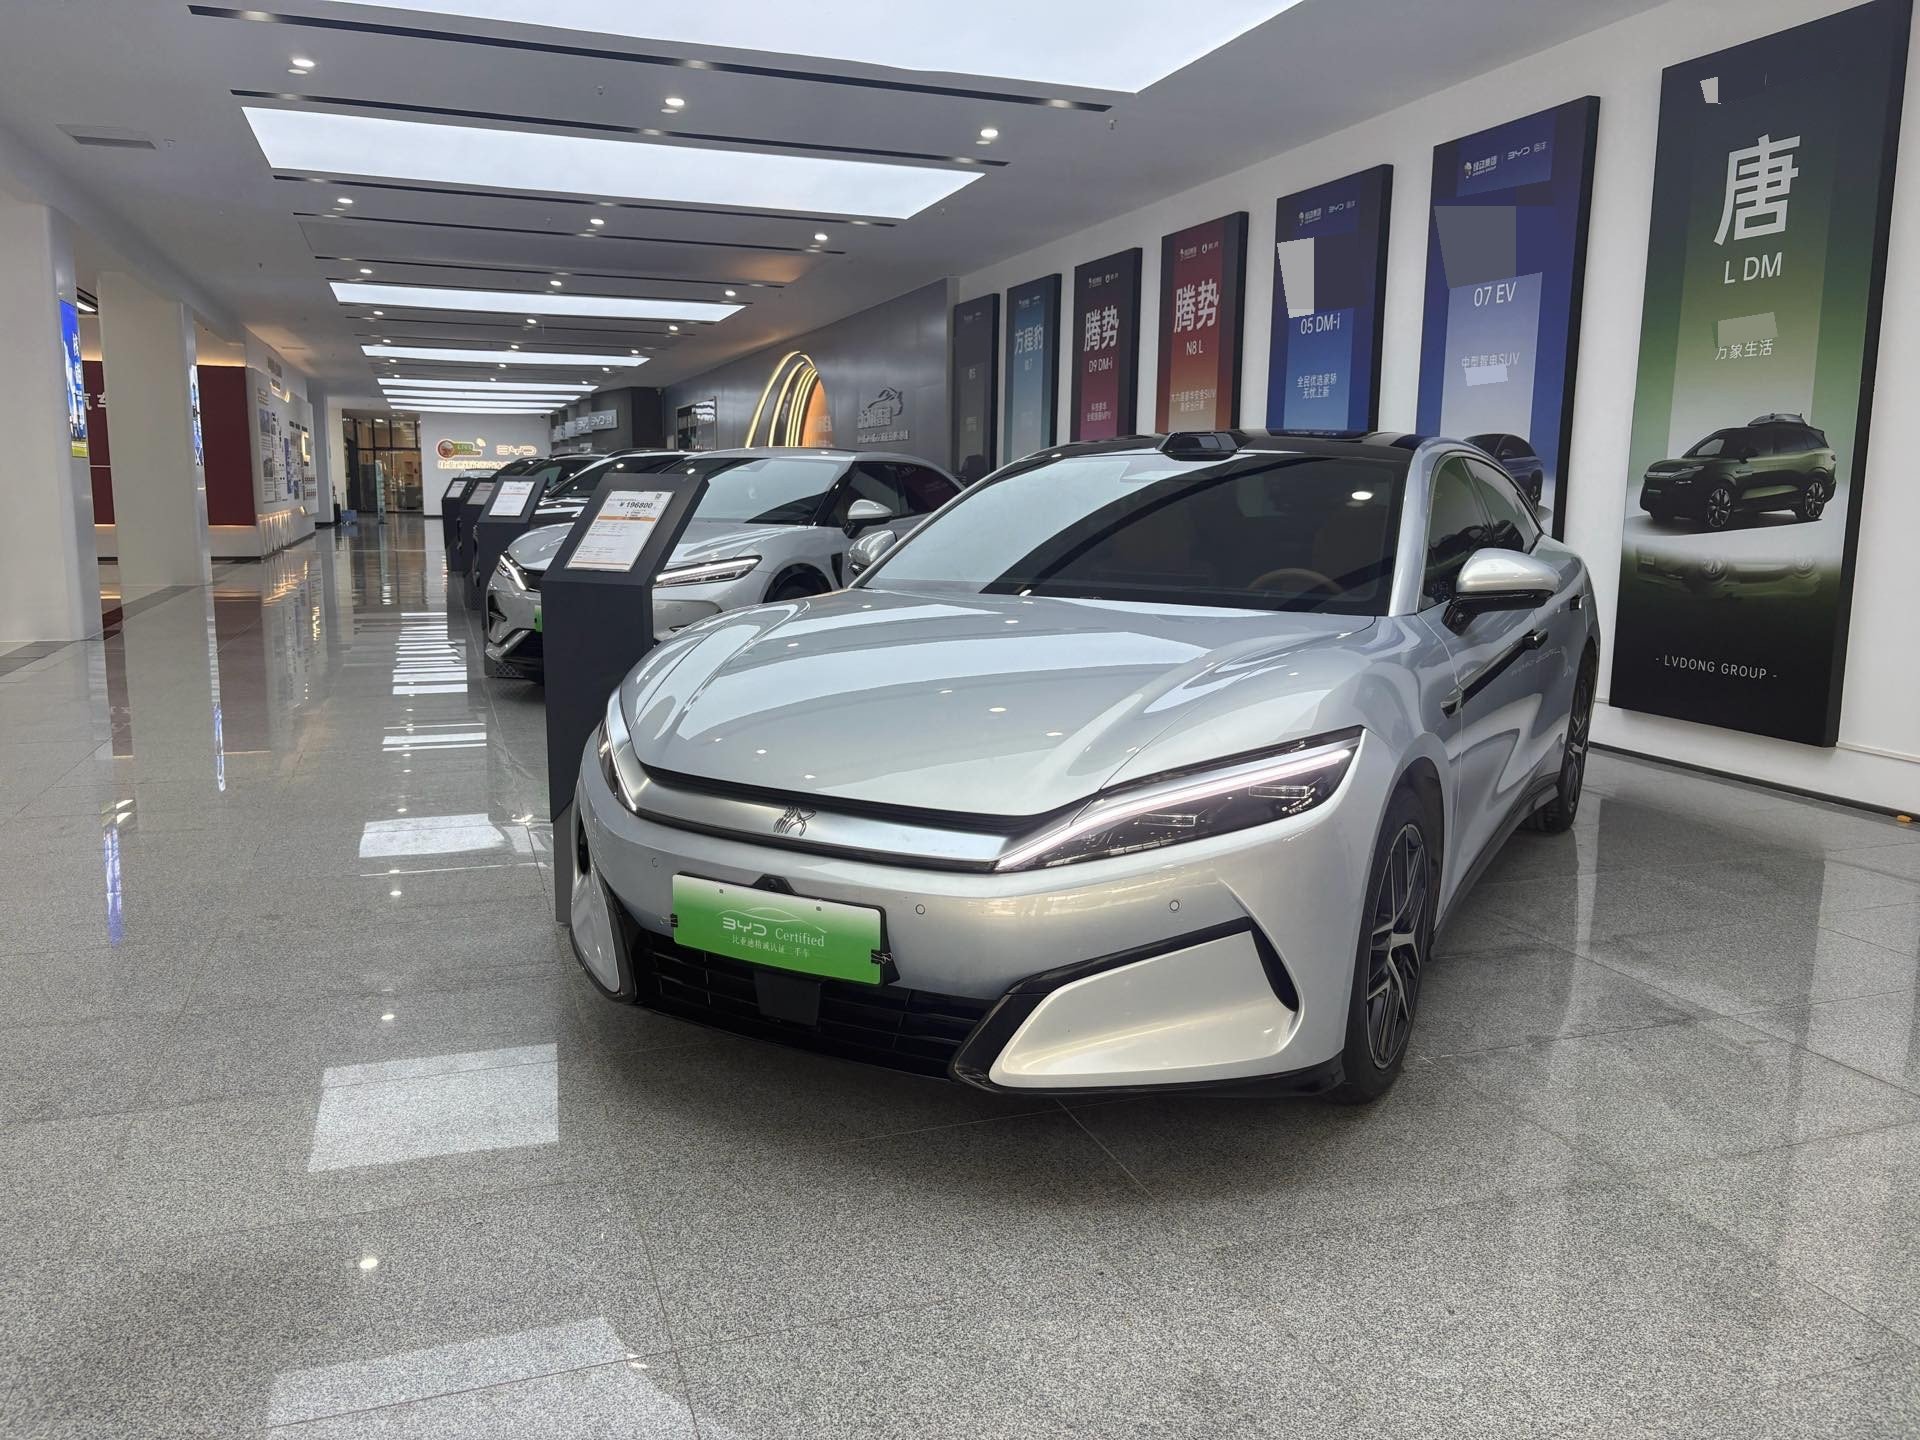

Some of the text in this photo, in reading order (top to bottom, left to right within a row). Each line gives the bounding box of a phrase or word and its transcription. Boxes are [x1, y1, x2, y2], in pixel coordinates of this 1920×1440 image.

[1507, 146, 1531, 160] BYD
[1713, 133, 1801, 246] 唐
[1724, 252, 1783, 284] L DM
[1173, 277, 1220, 334] 腾势
[1473, 281, 1517, 307] 07 EV
[1083, 304, 1120, 352] 腾势
[1300, 312, 1341, 335] 05 DM-i
[1014, 323, 1044, 355] 方程豹
[1186, 341, 1197, 356] N8
[496, 444, 537, 456] BYD
[1664, 654, 1767, 680] LVDONG GROUP
[722, 917, 825, 947] BYD Certified
